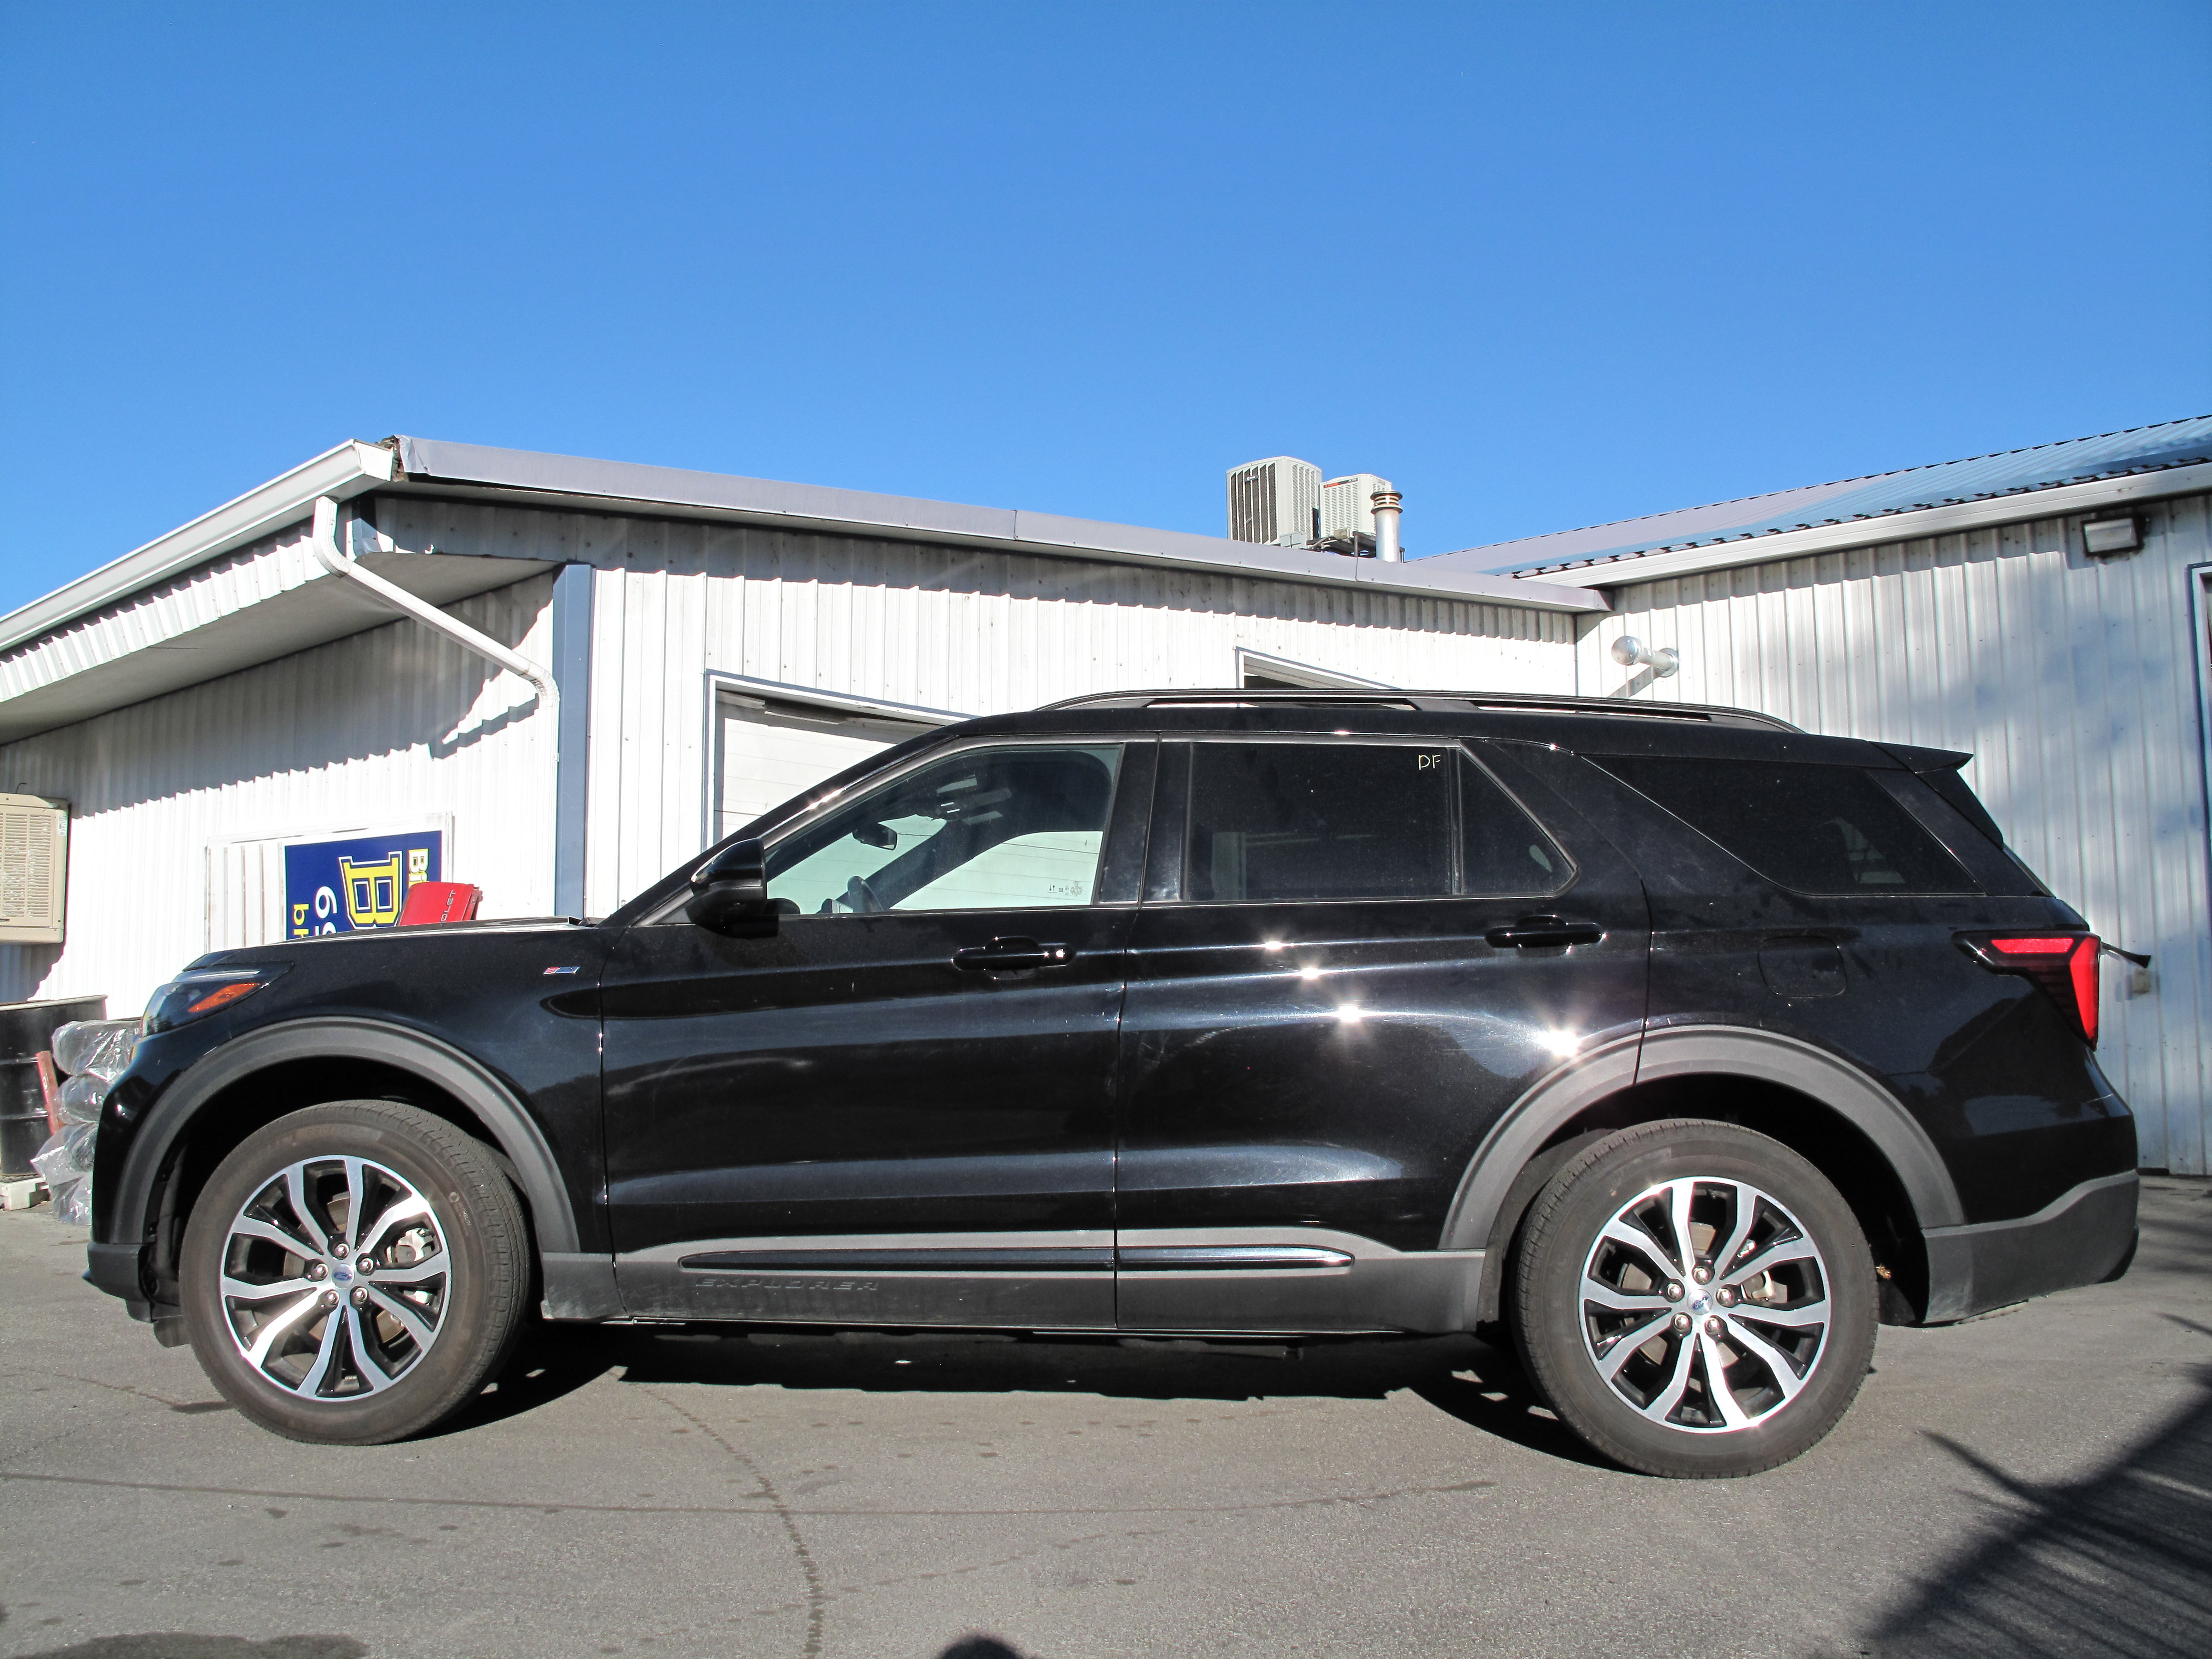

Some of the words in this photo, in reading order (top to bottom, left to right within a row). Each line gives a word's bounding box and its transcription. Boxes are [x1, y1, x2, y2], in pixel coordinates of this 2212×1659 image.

[1418, 754, 1441, 770] DF
[407, 849, 429, 888] Bi
[695, 1277, 878, 1291] EXPLORER
